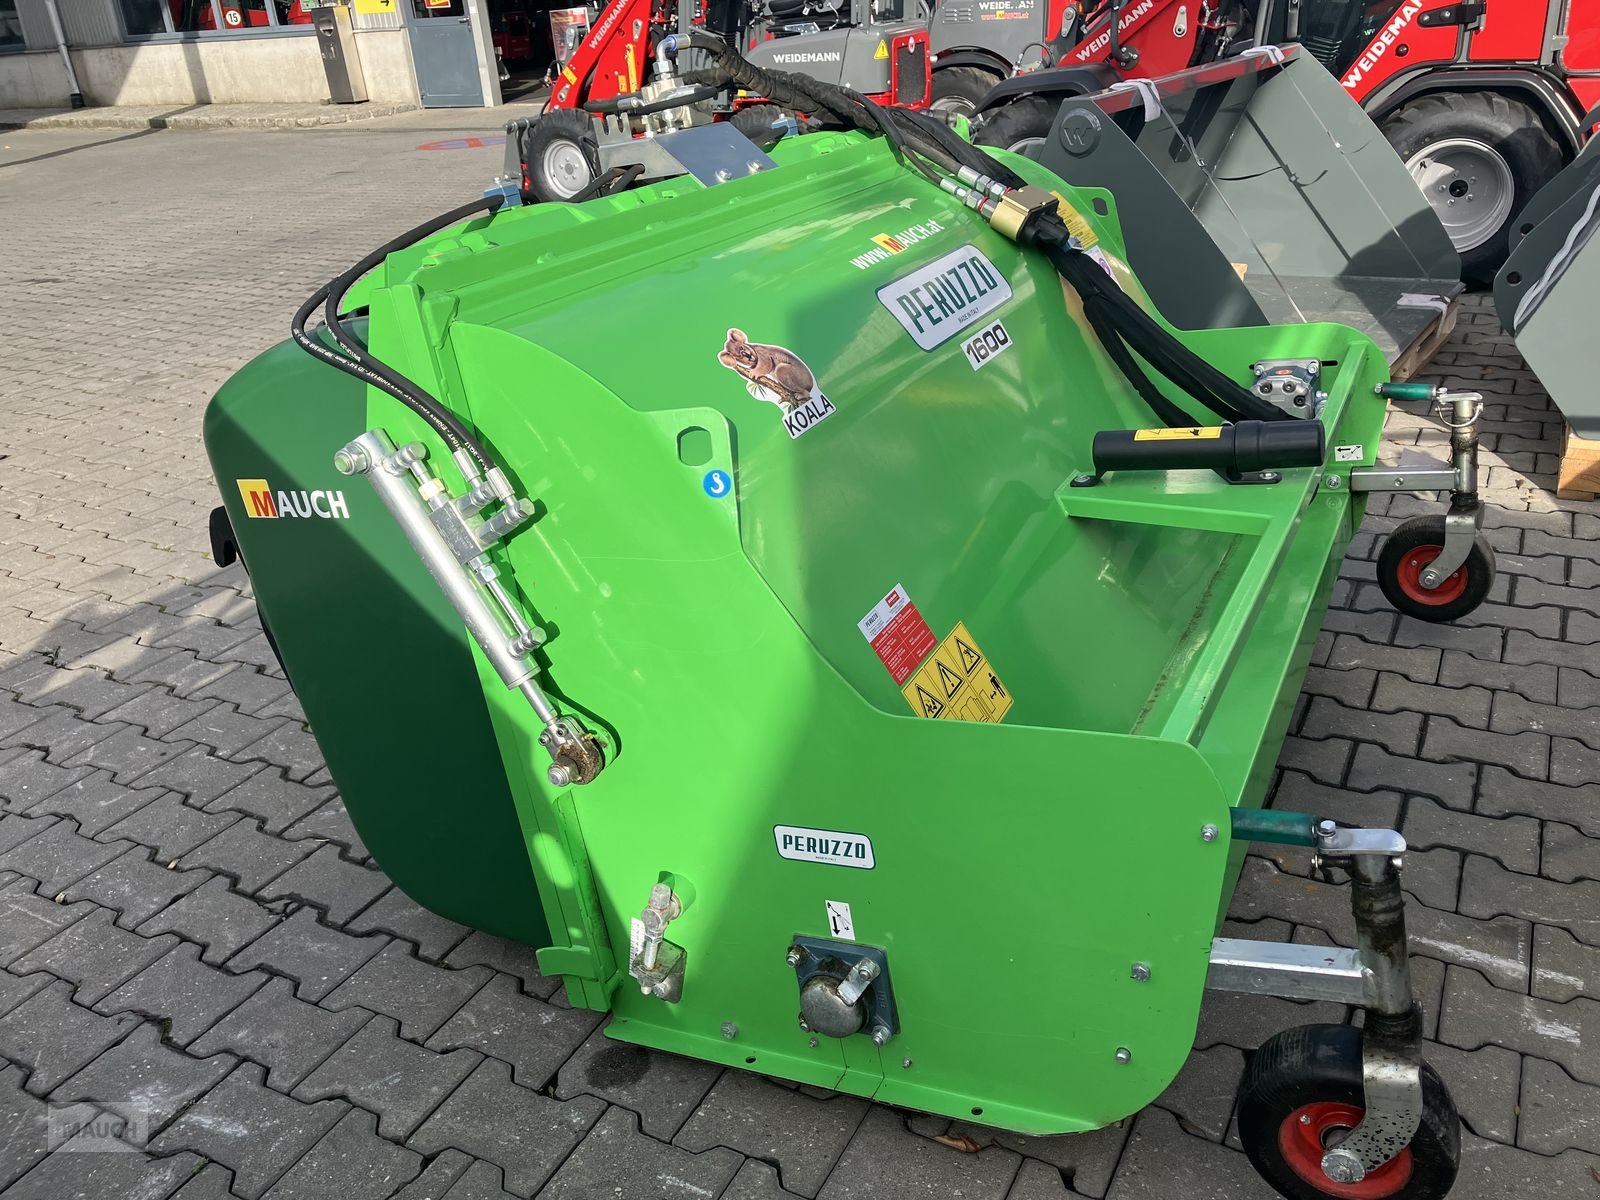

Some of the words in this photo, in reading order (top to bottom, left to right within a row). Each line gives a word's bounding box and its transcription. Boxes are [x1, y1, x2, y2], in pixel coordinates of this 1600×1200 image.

[228, 13, 238, 23] 15
[773, 52, 840, 63] WEIDEMANN
[849, 218, 945, 270] www.MAUCH.at
[896, 255, 998, 334] PERUZZO
[966, 323, 1009, 364] 1600
[784, 395, 835, 437] KOALA
[249, 489, 350, 519] MAUCH
[783, 834, 866, 859] PERUZZO
